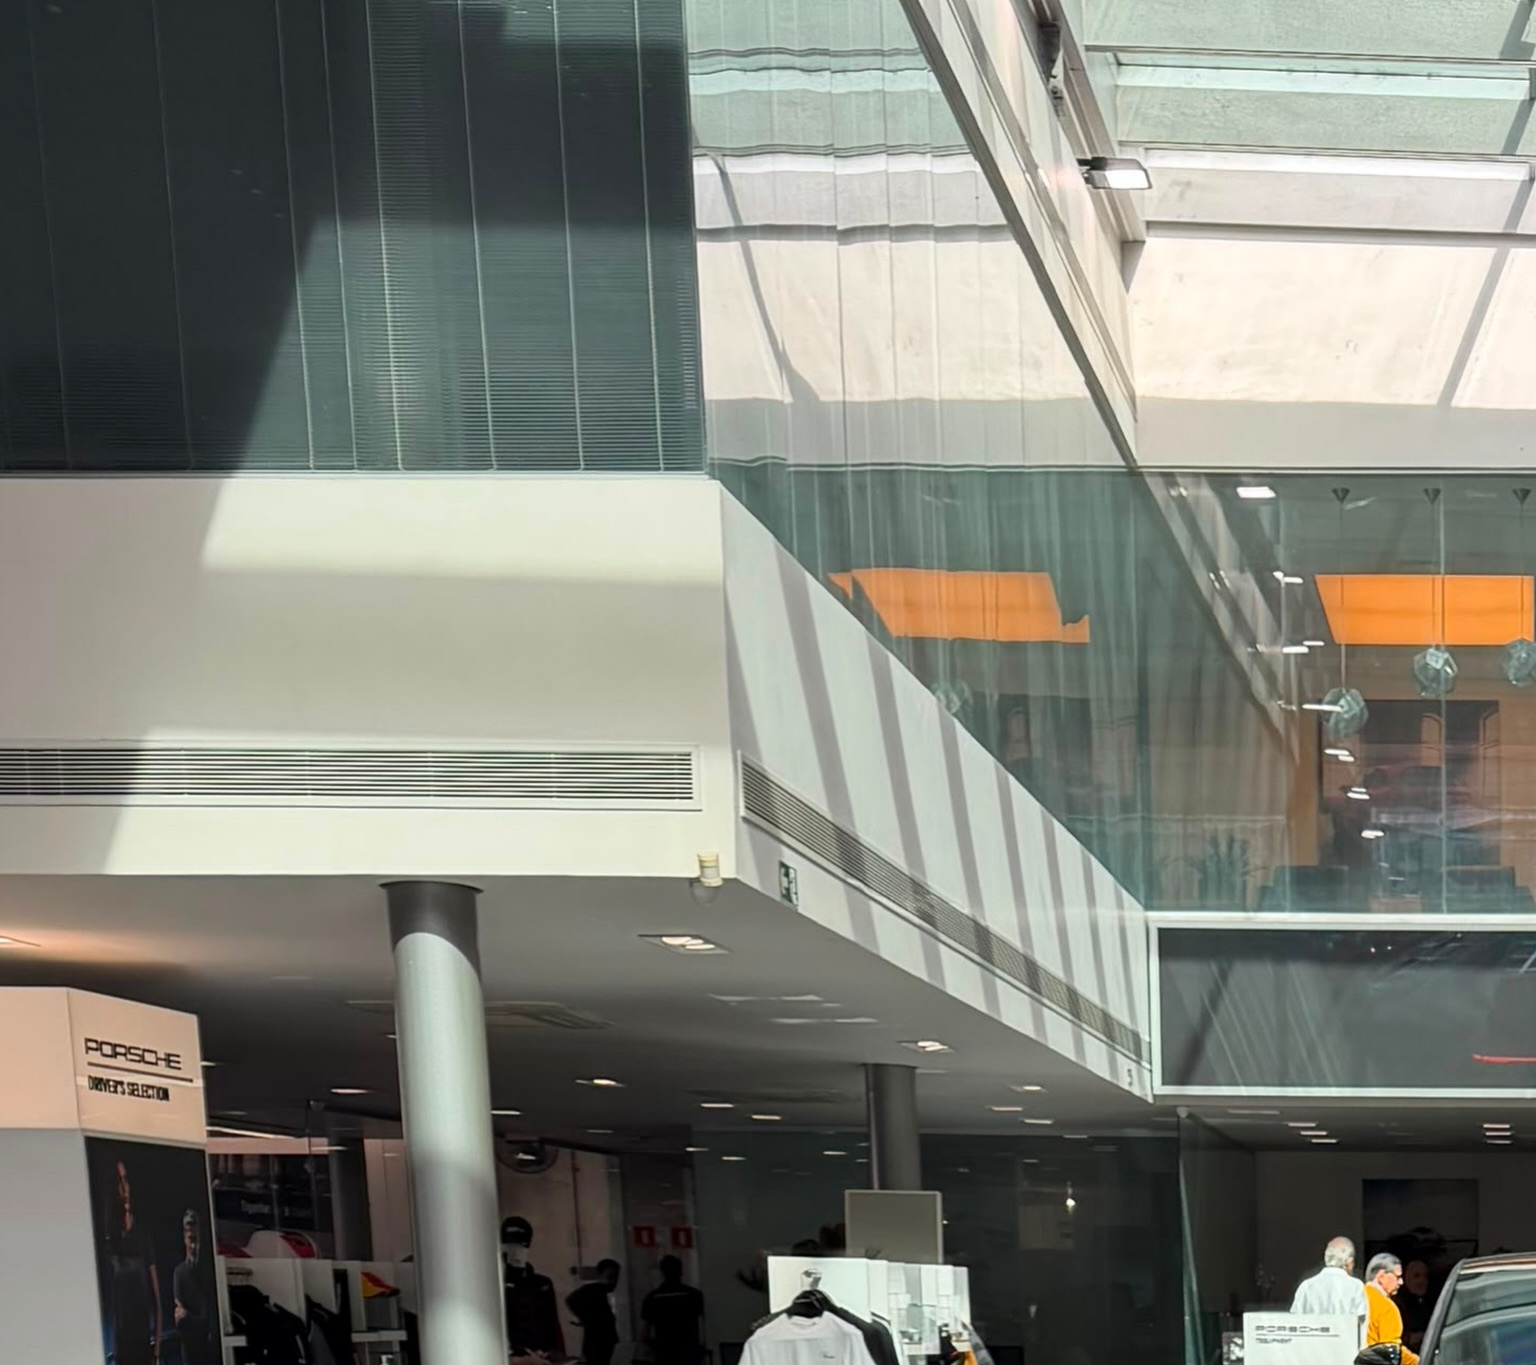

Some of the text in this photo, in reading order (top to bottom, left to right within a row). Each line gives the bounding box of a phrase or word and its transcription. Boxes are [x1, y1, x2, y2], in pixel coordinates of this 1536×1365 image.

[84, 1037, 182, 1070] PORSCHE
[126, 1082, 170, 1102] SELECTION
[1255, 1325, 1330, 1333] PORSCHE
